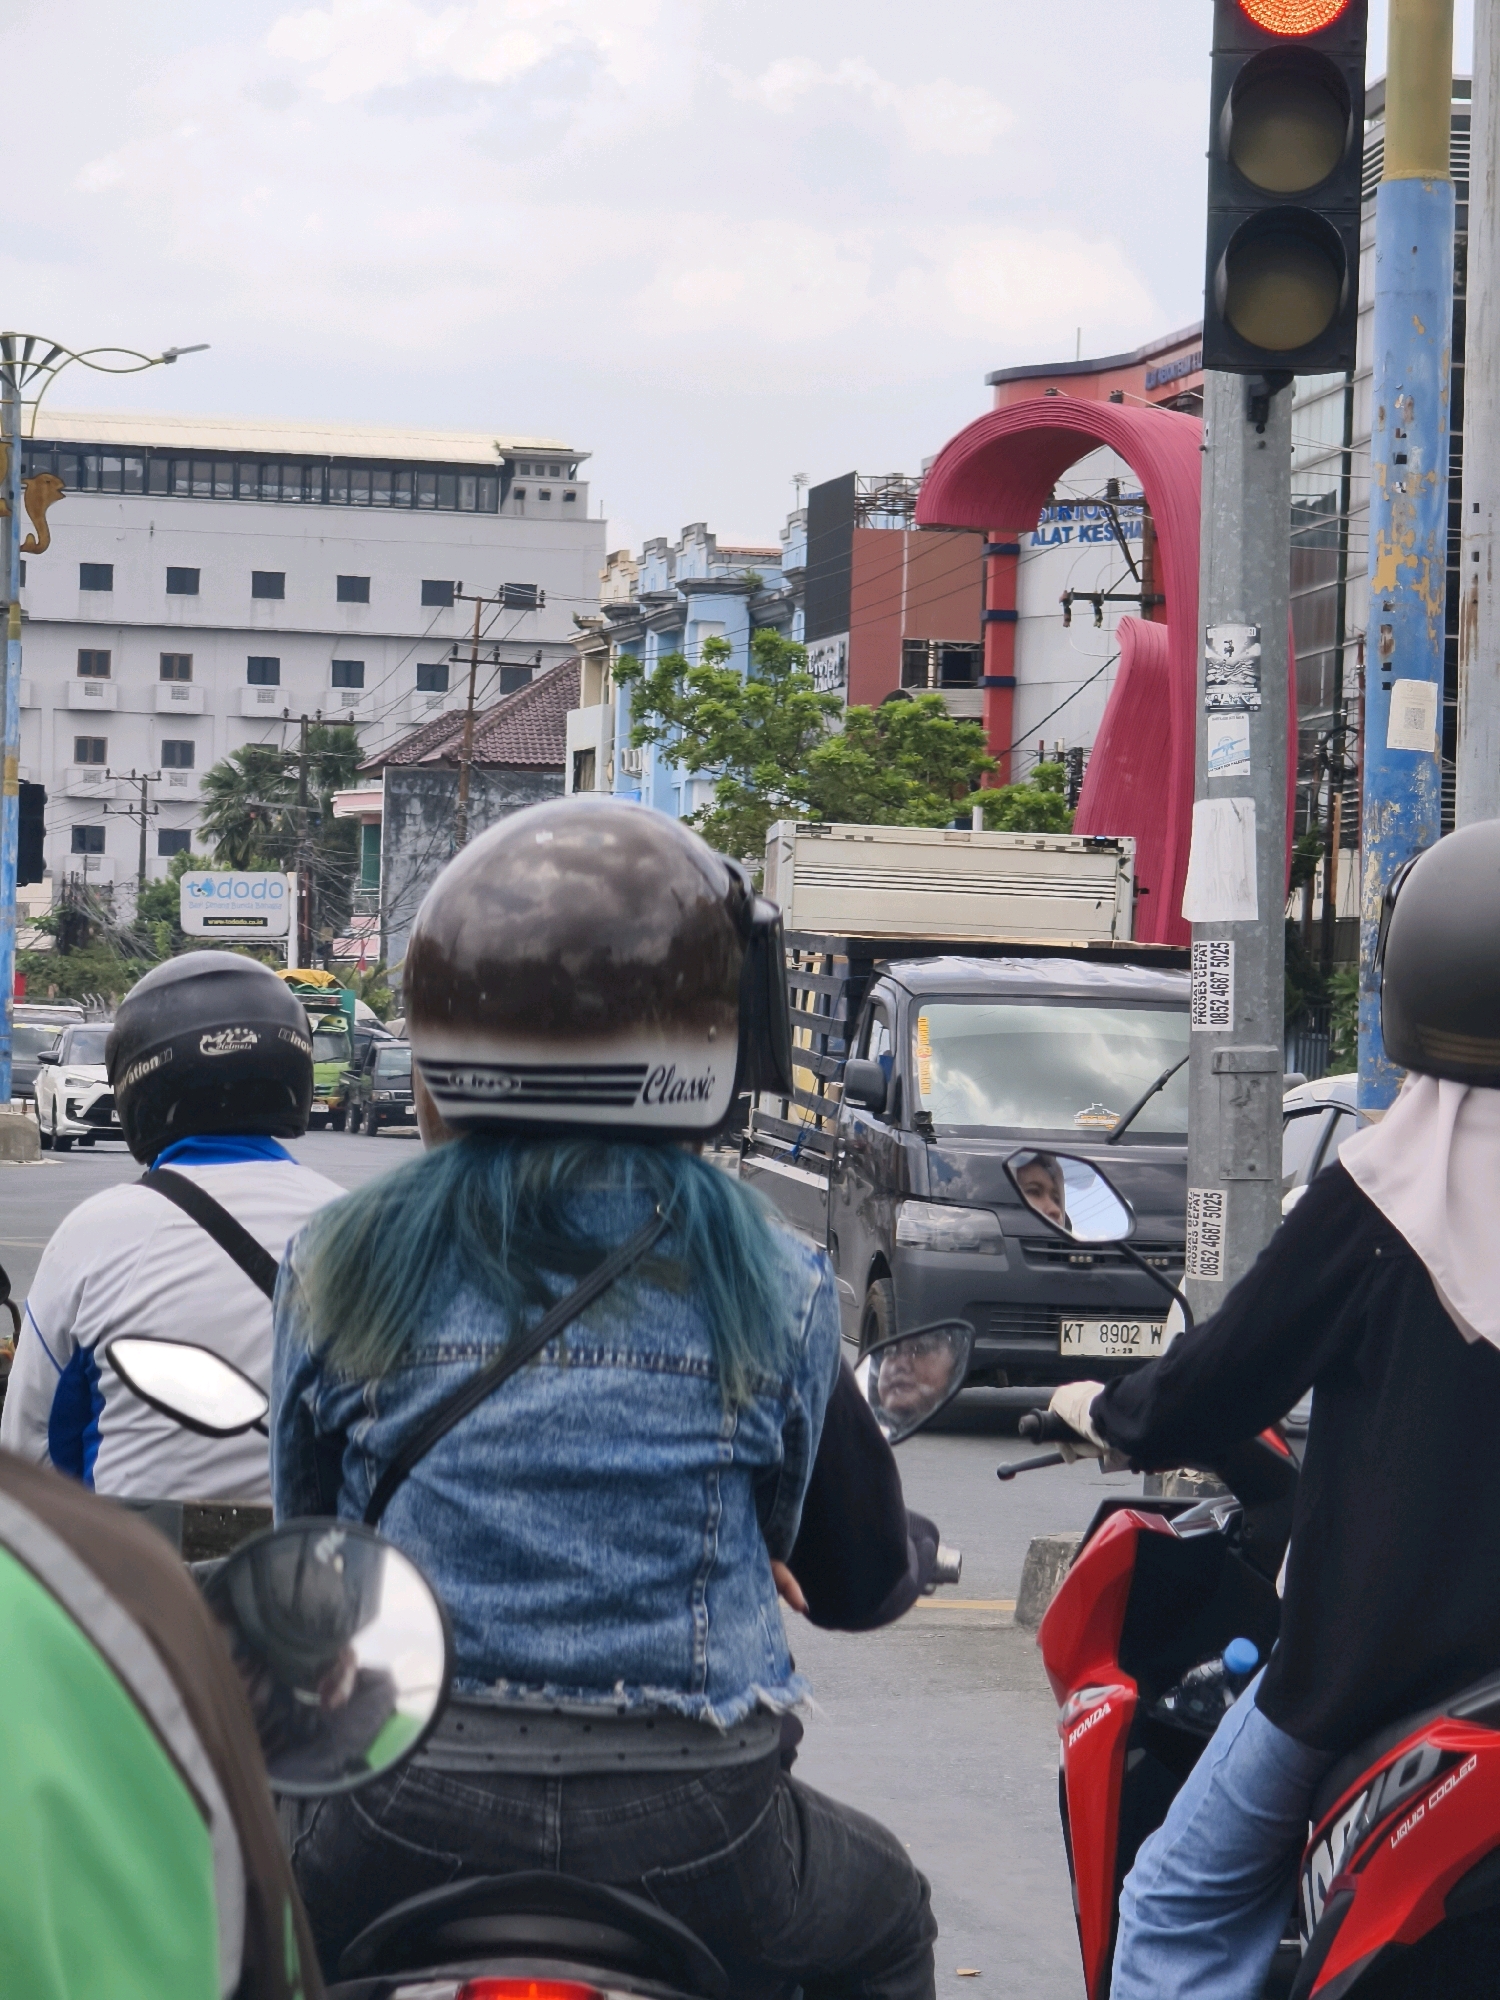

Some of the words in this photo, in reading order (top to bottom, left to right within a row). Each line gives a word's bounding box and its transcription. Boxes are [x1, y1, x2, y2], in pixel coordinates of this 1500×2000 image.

[1030, 526, 1074, 546] ALAT
[1198, 943, 1207, 977] CEPAT
[1210, 942, 1229, 967] 5025
[1210, 971, 1229, 996] 4687
[1197, 981, 1207, 1024] PROSES
[1210, 999, 1229, 1024] 0852
[1192, 1191, 1200, 1227] CEPAT
[1203, 1192, 1222, 1218] 5025
[1201, 1221, 1221, 1248] 4687
[1191, 1230, 1199, 1274] PROSES
[1200, 1250, 1220, 1276] 0852
[1063, 1324, 1084, 1343] KT
[1100, 1324, 1140, 1344] 8902
[1150, 1325, 1163, 1344] W
[1068, 1702, 1111, 1748] HONDA
[1390, 1804, 1425, 1849] LIQUID
[1428, 1754, 1477, 1809] COOLED
